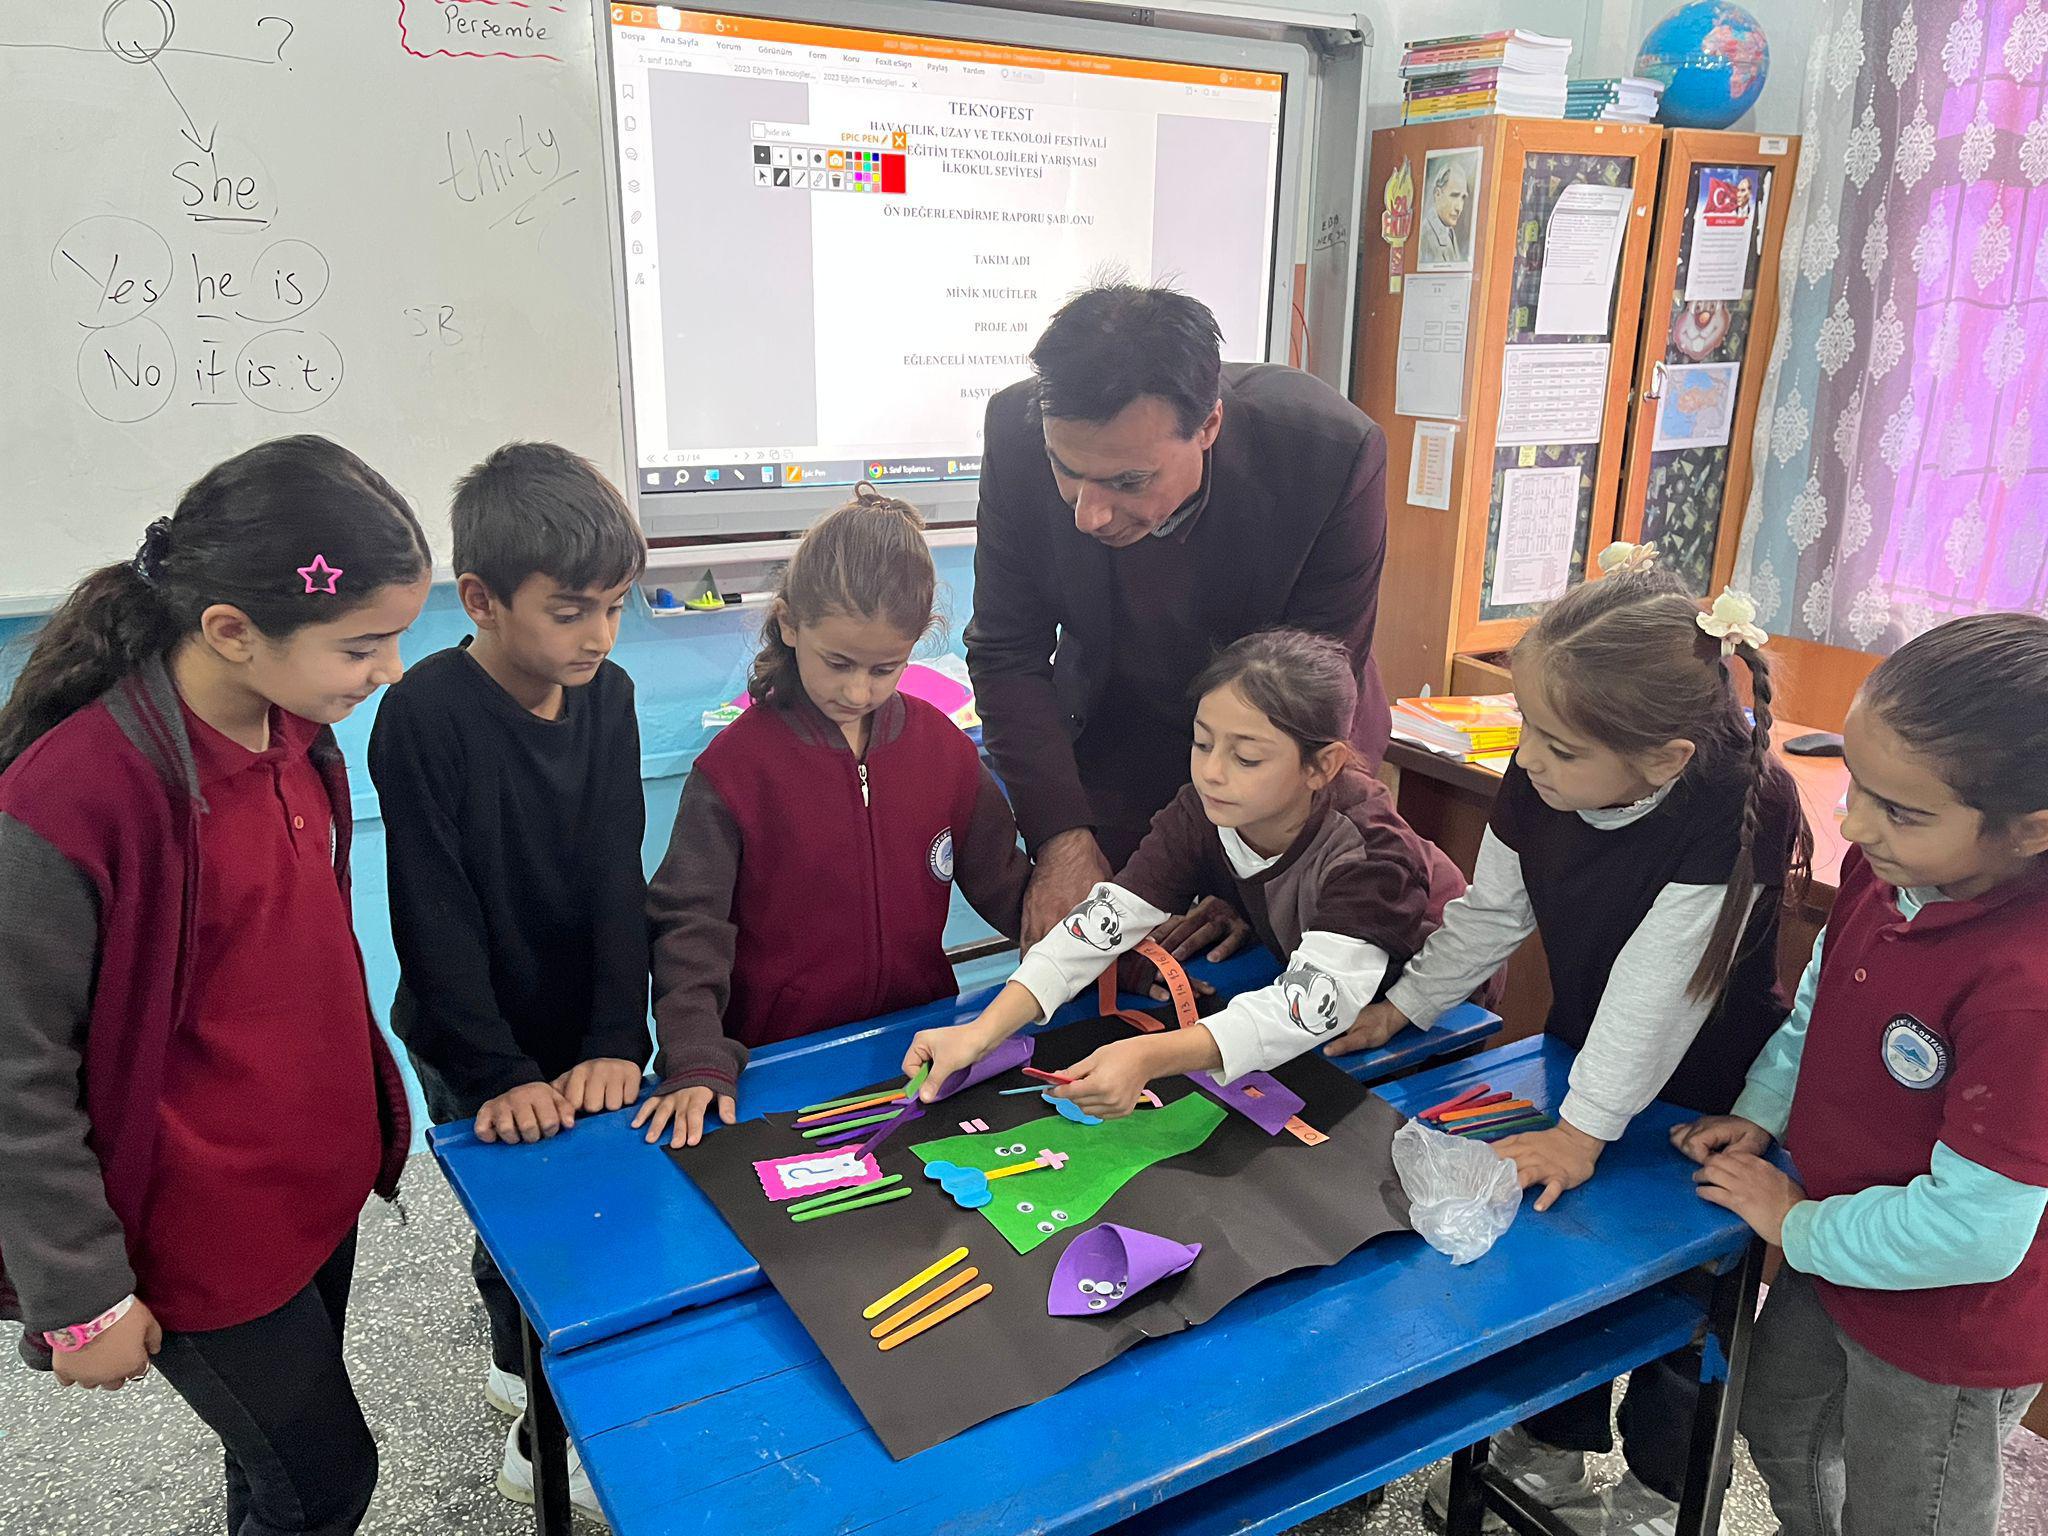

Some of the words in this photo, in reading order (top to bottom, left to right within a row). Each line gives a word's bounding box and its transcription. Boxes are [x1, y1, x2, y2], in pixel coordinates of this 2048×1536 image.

[445, 4, 552, 39] Perşembe
[621, 31, 646, 42] Dosya
[660, 35, 676, 45] Ana
[677, 37, 699, 48] Sayfa
[716, 40, 742, 51] Yorum
[758, 46, 793, 58] Görünüm
[808, 50, 827, 60] Form
[842, 54, 861, 63] Koru
[948, 101, 1034, 121] TEKNOFEST
[841, 132, 861, 142] EPIC
[862, 133, 880, 144] PEN
[941, 127, 971, 140] UZAY
[973, 128, 989, 141] VE
[991, 130, 1052, 145] TEKNOLOJİ
[1054, 134, 1107, 149] FESTİVALİ
[438, 114, 561, 202] thirty
[941, 162, 993, 176] İLKOKUL
[883, 203, 901, 217] ÖN
[903, 205, 1000, 222] DEĞERLENDİRME
[1001, 211, 1045, 224] RAPORU
[973, 254, 1010, 266] TAKIM
[1011, 256, 1031, 266] ADI
[60, 249, 158, 313] Yes
[191, 252, 242, 303] he
[274, 269, 304, 305] is
[945, 286, 981, 299] MİNİK
[982, 287, 1038, 300] MUCİTLER
[974, 322, 1008, 333] PROJE
[1009, 322, 1029, 333] ADI
[903, 353, 966, 366] EĞLENCELİ
[103, 343, 161, 391] No
[195, 349, 228, 394] it
[1175, 983, 1187, 996] 14
